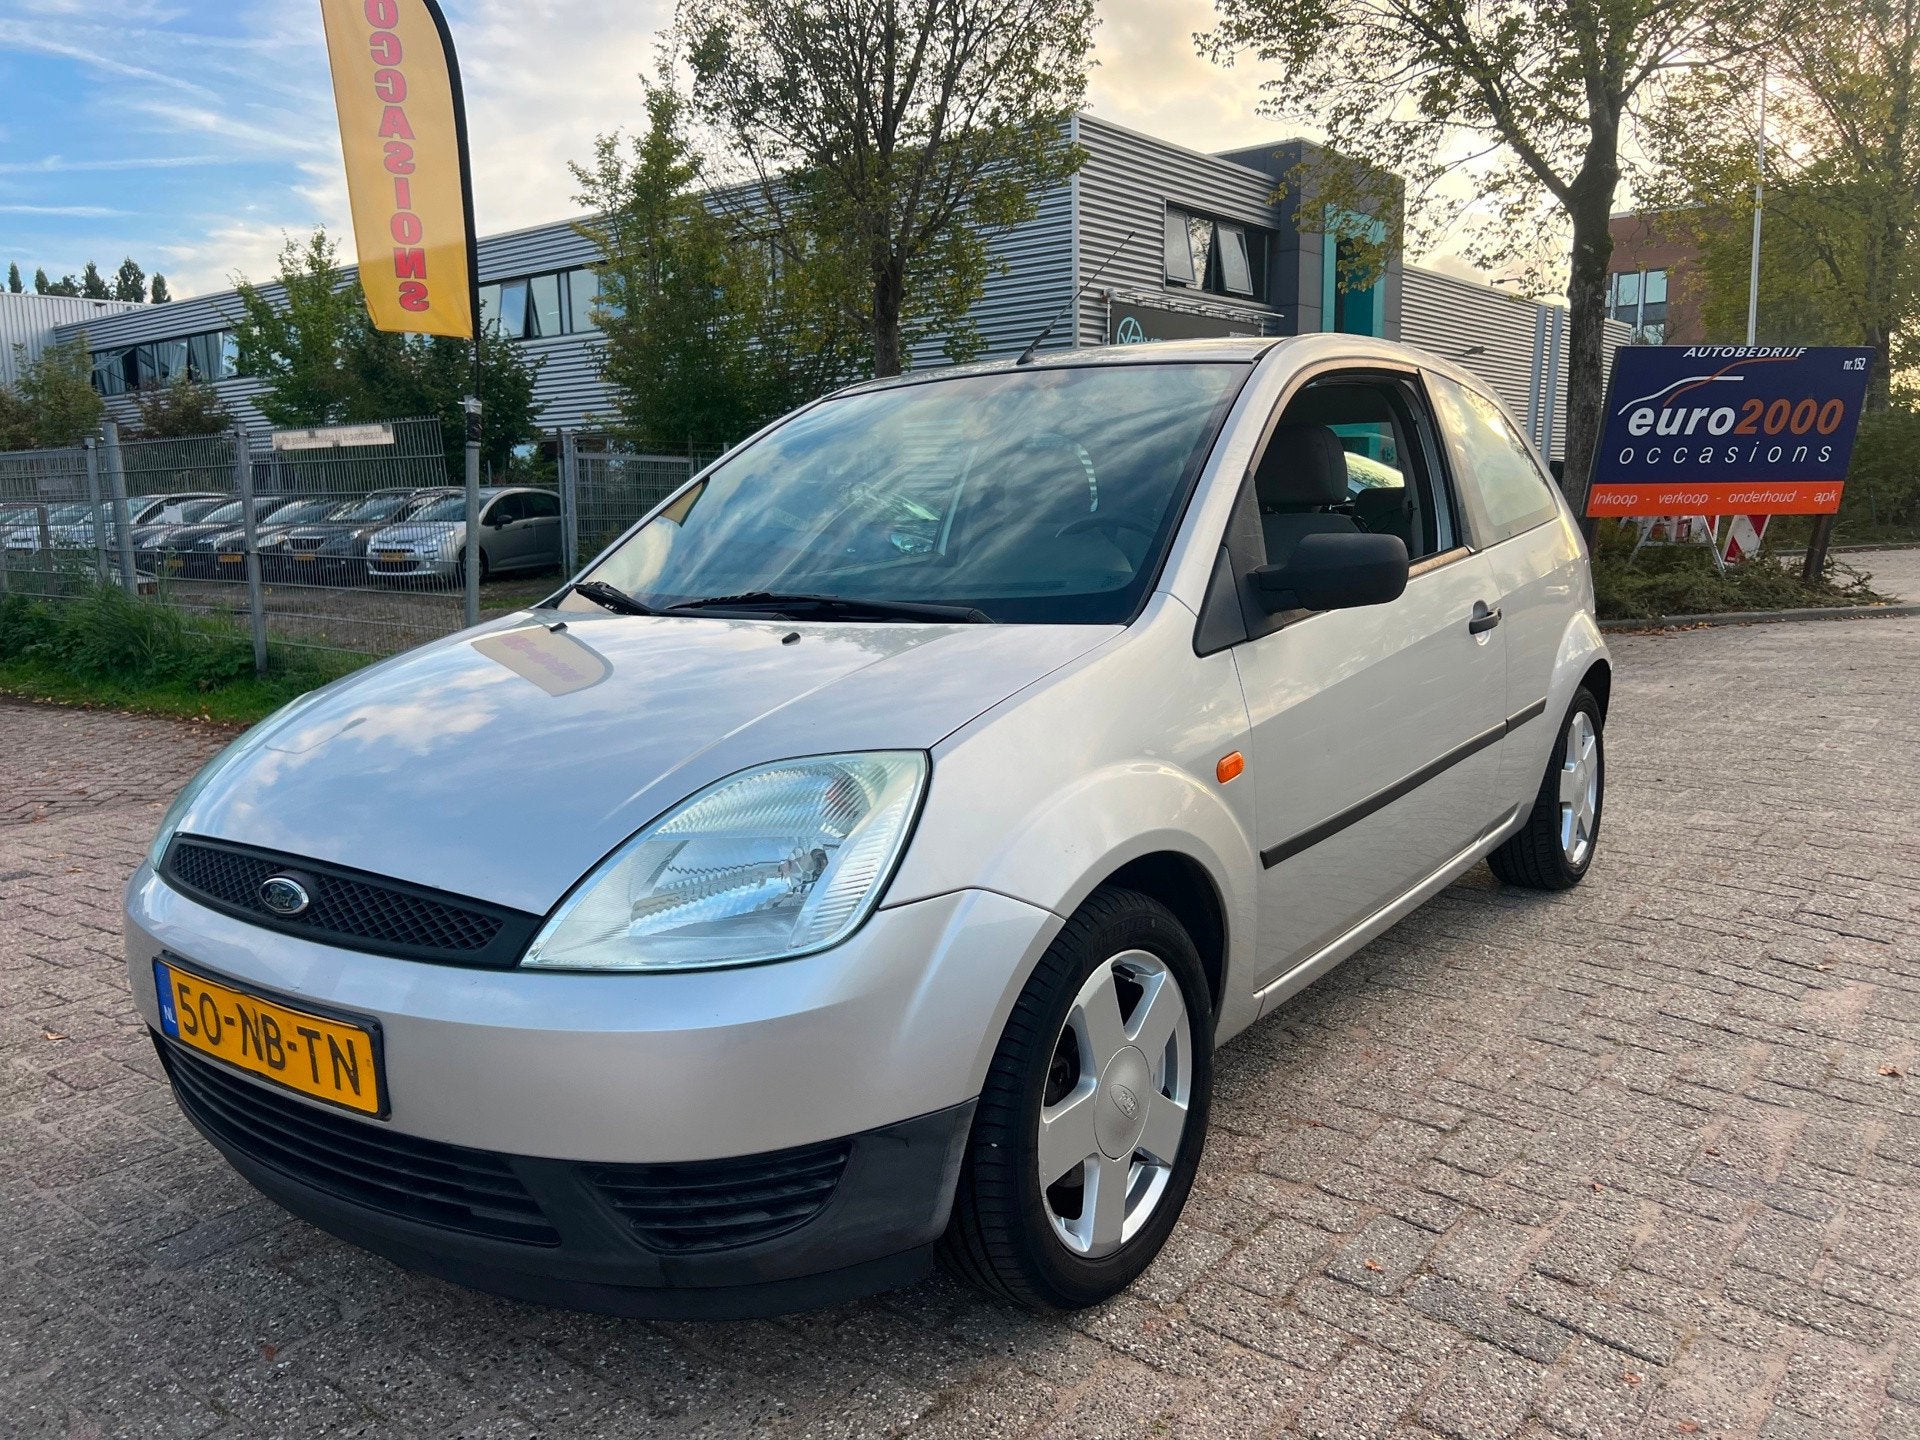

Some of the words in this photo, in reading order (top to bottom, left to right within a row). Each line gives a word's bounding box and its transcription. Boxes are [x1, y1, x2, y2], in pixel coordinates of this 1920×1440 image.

[1683, 347, 1807, 358] AUTOBEDRIJF
[1628, 399, 1844, 435] euro2000
[1619, 442, 1832, 465] occasions
[1594, 492, 1638, 506] Inkoop
[1659, 491, 1709, 504] verkoop
[1728, 491, 1797, 503] onderhoud
[1813, 490, 1838, 503] apk
[177, 983, 360, 1095] 50-NB-TN
